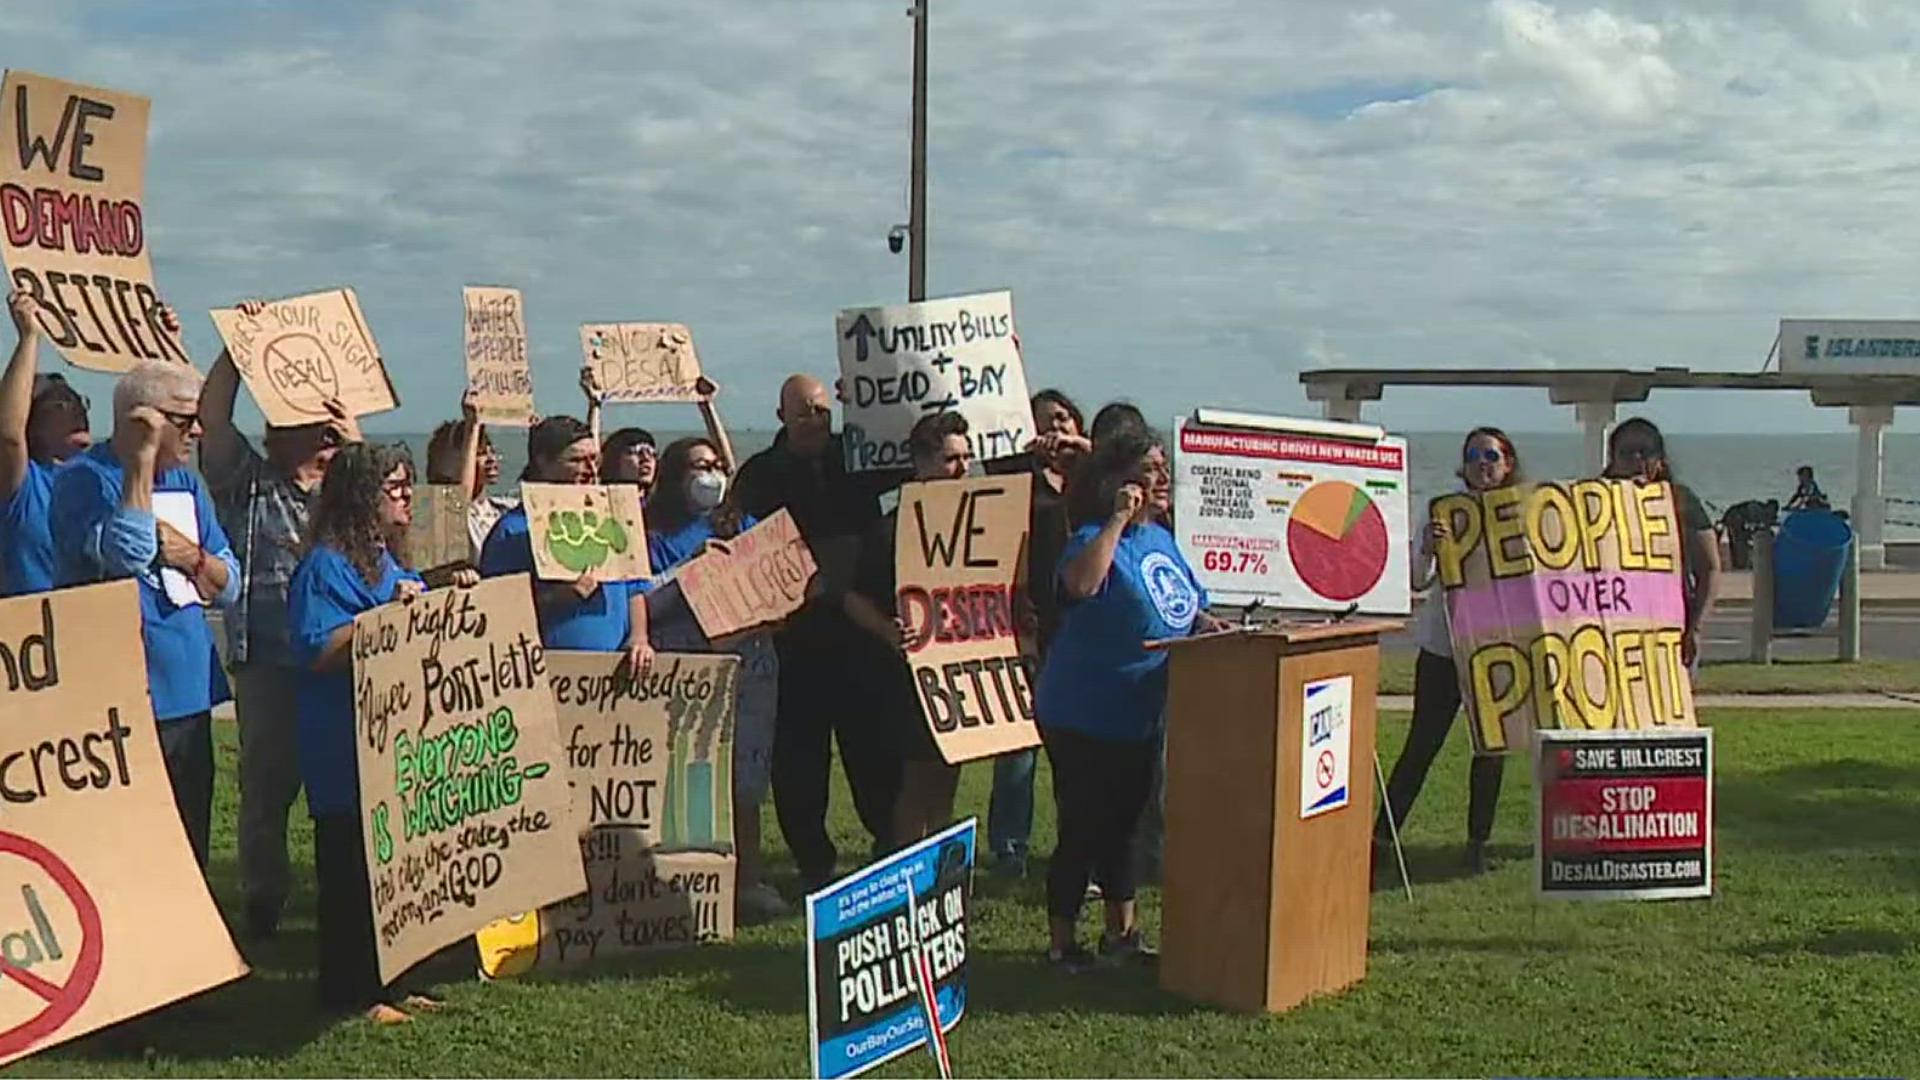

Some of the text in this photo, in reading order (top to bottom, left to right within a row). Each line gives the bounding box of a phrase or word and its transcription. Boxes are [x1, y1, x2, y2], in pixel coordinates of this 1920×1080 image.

[16, 84, 114, 181] WE
[0, 183, 144, 258] DEMAND
[12, 267, 190, 364] BETTER
[878, 310, 1008, 354] UTILITY BILLS
[269, 305, 320, 333] YOUR
[328, 322, 377, 374] SIGN
[273, 357, 332, 389] DESAL
[602, 354, 686, 390] DESAL
[854, 362, 1006, 409] DEAD BAY
[1182, 432, 1399, 463] MANUFACTURING DRIVES NEW WATER USE
[1191, 465, 1233, 477] COASTAL
[914, 489, 1004, 568] WE
[1430, 479, 1674, 590] PEOPLE
[1204, 551, 1268, 575] 69.7%
[1547, 577, 1632, 613] OVER
[577, 658, 681, 714] supposed
[682, 672, 711, 702] to
[1470, 625, 1684, 752] PROFIT
[566, 723, 653, 769] for the
[1576, 748, 1703, 769] SAVE HILLCREST
[590, 777, 656, 824] NOT
[1602, 787, 1656, 812] STOP
[371, 800, 394, 865] IS
[1552, 813, 1698, 839] DESALINATION
[450, 852, 502, 906] GOD
[669, 871, 721, 895] even
[556, 927, 604, 962] pay
[838, 923, 892, 976] PUSH
[944, 885, 964, 925] ON
